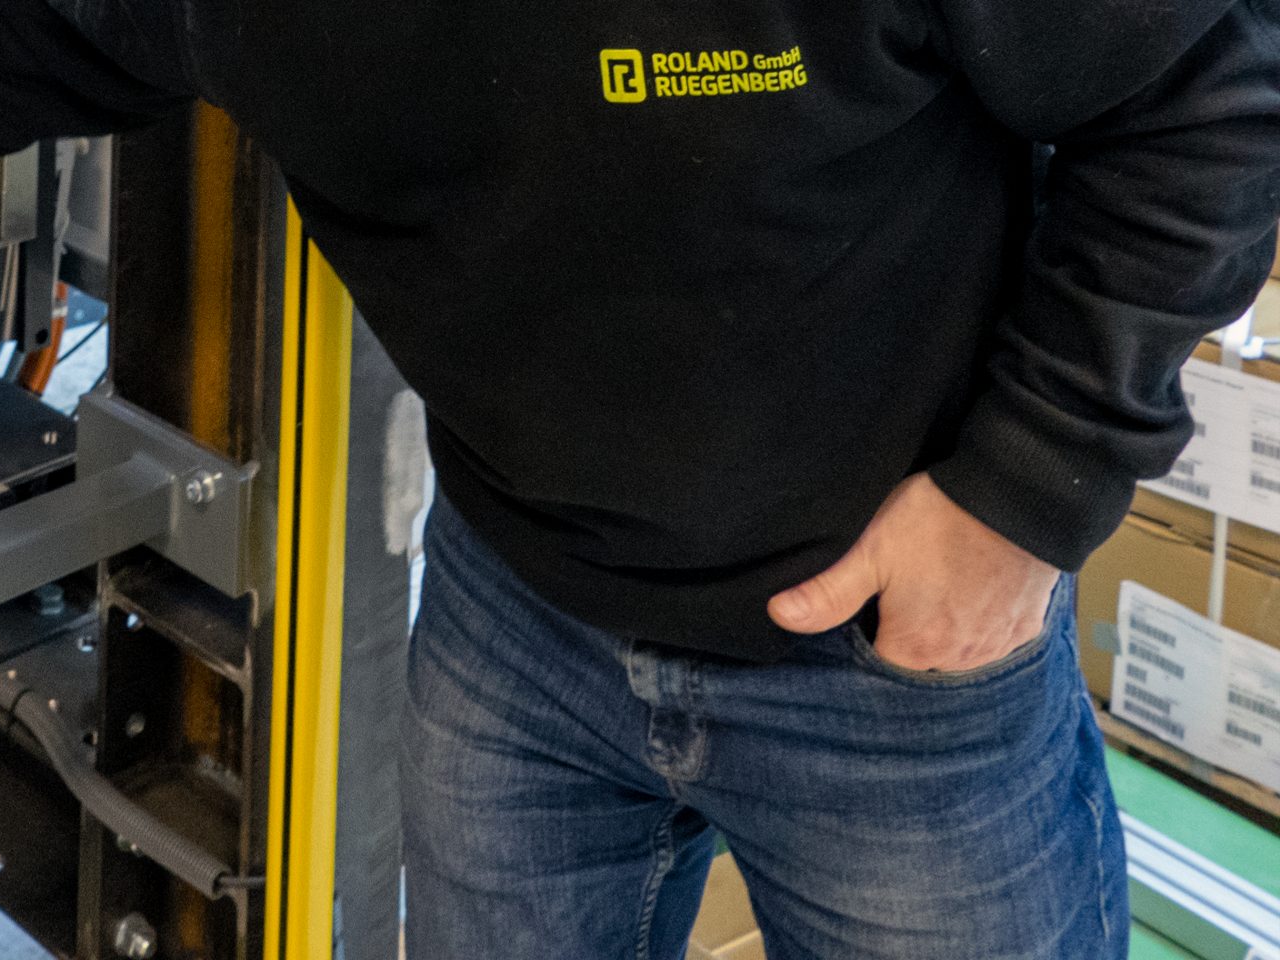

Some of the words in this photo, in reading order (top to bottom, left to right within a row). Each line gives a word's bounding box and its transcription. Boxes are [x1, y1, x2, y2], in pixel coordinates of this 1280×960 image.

[651, 50, 749, 74] ROLAND
[753, 46, 802, 70] GmbH
[655, 65, 808, 97] RUEGENBERG
